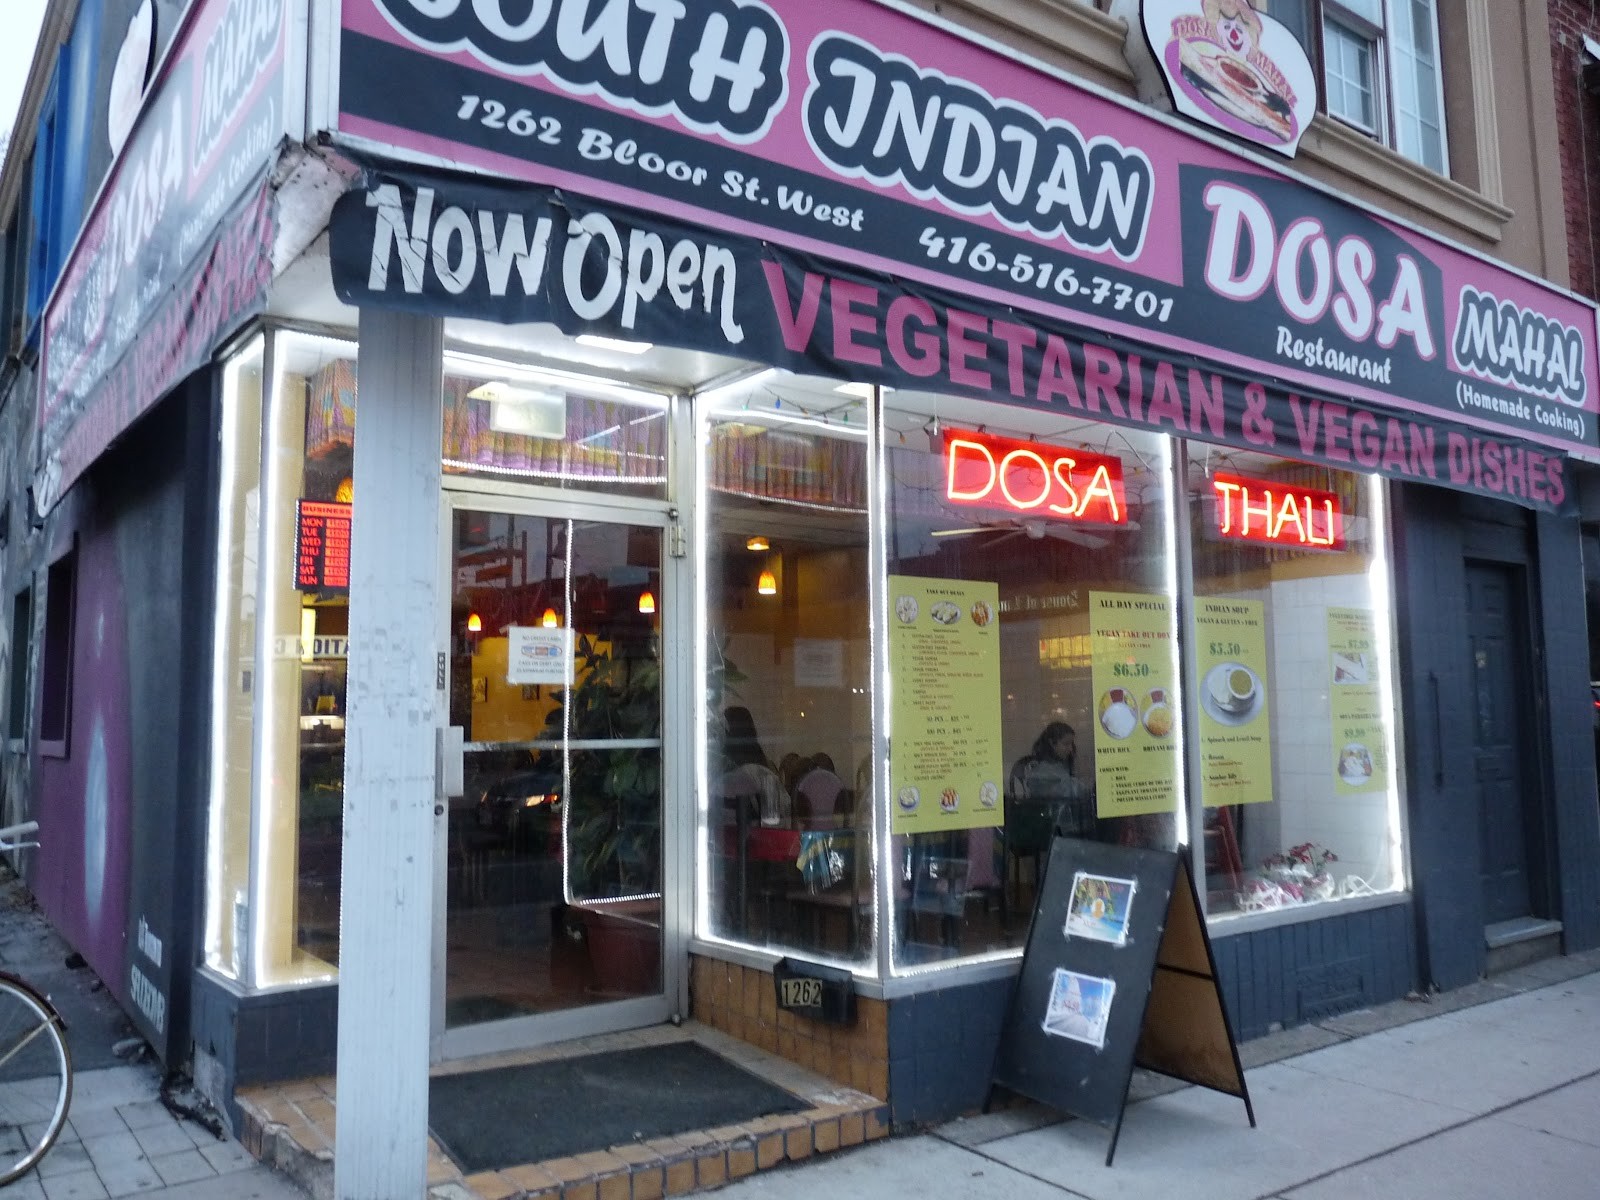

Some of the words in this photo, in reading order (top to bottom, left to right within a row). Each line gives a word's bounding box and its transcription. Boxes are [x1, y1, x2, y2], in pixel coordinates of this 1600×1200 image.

[400, 0, 767, 114] UTH
[823, 57, 1140, 240] INDIAN
[457, 95, 561, 145] 1262
[578, 128, 708, 186] Bloor
[776, 186, 864, 232] West
[919, 227, 1173, 322] 416-516-7701
[1206, 183, 1433, 359] DOSA
[562, 213, 745, 345] Open
[761, 259, 1227, 440] VEGETARIAN
[1241, 382, 1275, 448] &
[1288, 396, 1437, 480] VEGAN
[1449, 433, 1565, 505] DISHES
[1277, 327, 1391, 384] Restaurant
[1463, 299, 1582, 391] MAHAL
[1456, 380, 1531, 420] (Homemade
[1534, 404, 1587, 439] Cooking)
[947, 439, 1120, 523] DOSA
[301, 518, 323, 527] MON
[301, 527, 318, 537] TUE
[1214, 480, 1335, 546] THALI
[300, 546, 320, 556] THU
[300, 556, 314, 566] FRI
[301, 537, 322, 547] WED
[299, 566, 316, 575] SAT
[299, 576, 319, 585] SUN
[1100, 600, 1116, 608] ALL
[1117, 601, 1132, 609] DAY
[1135, 601, 1166, 611] SPECIAL
[1205, 605, 1230, 613] INDIAN
[1232, 606, 1249, 614] SOUP
[783, 980, 821, 1006] 1262
